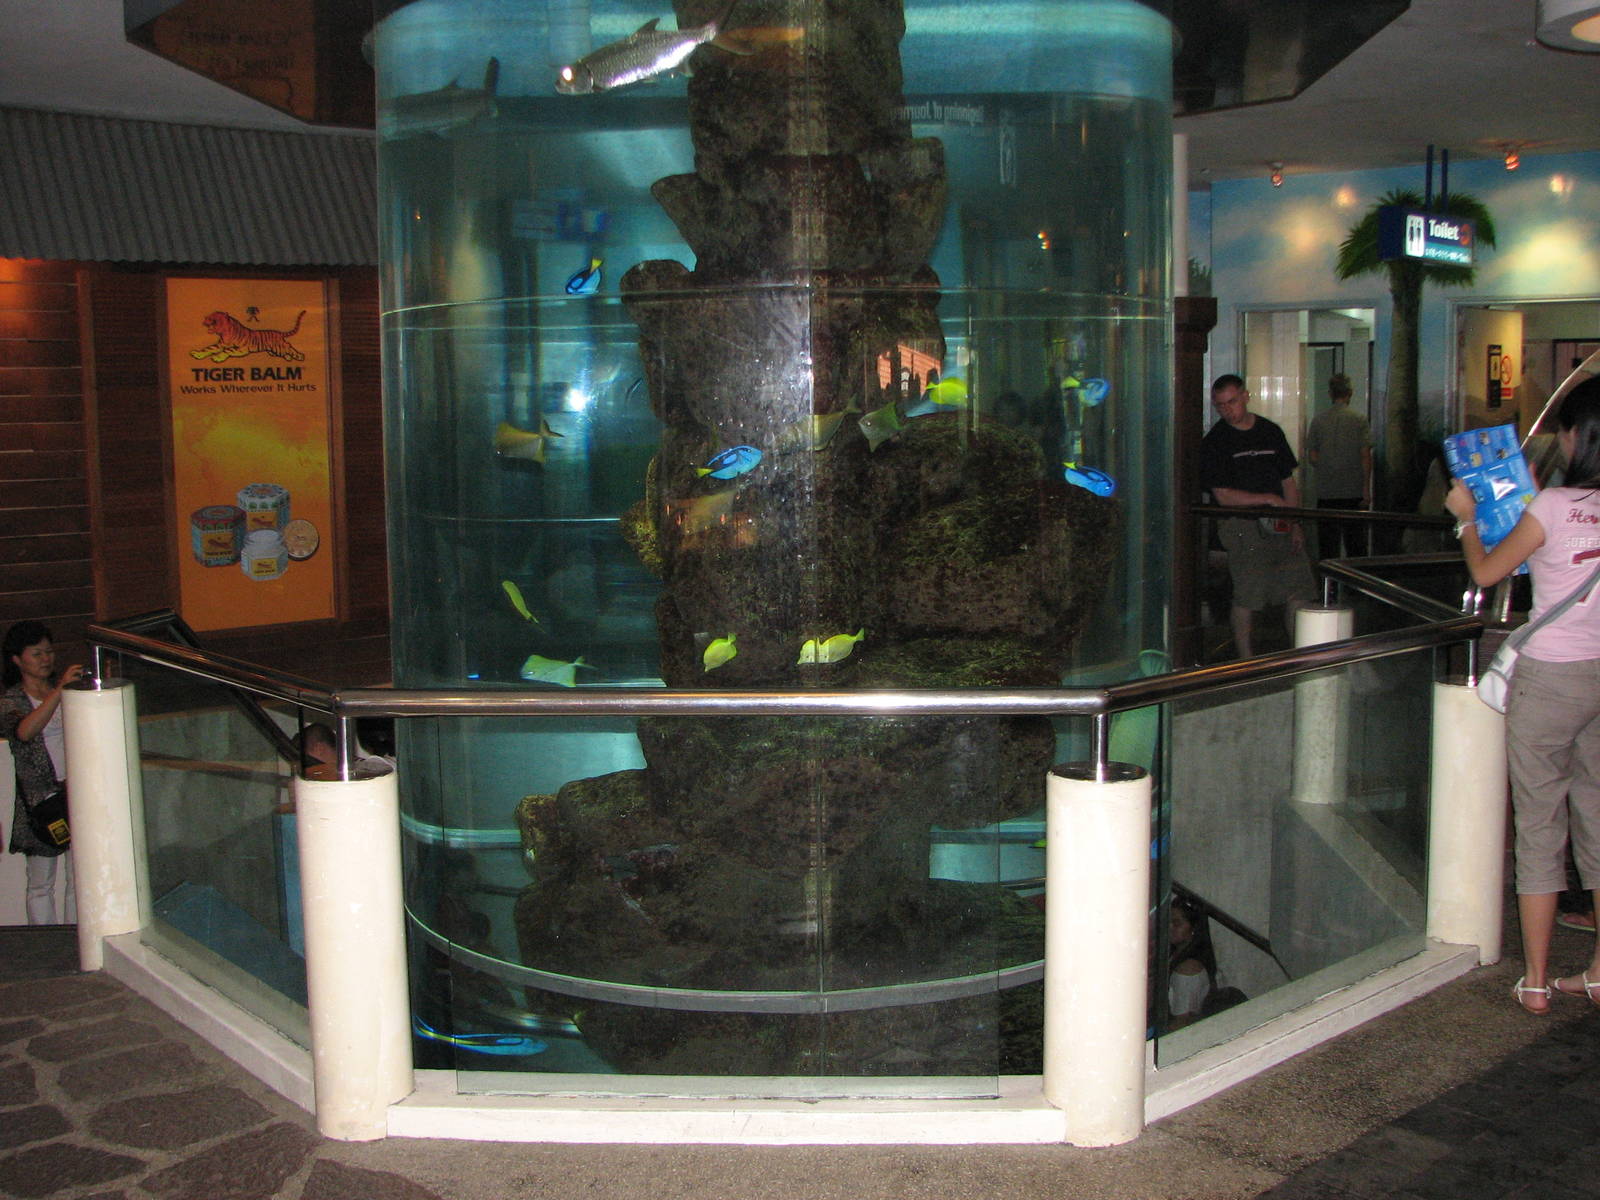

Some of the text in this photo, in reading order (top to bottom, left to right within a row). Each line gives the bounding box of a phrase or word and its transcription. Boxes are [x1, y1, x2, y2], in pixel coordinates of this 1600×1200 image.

[1428, 219, 1460, 240] Toilet
[191, 366, 303, 382] TIGER BALM
[180, 383, 317, 395] Works Wherever It Hurts
